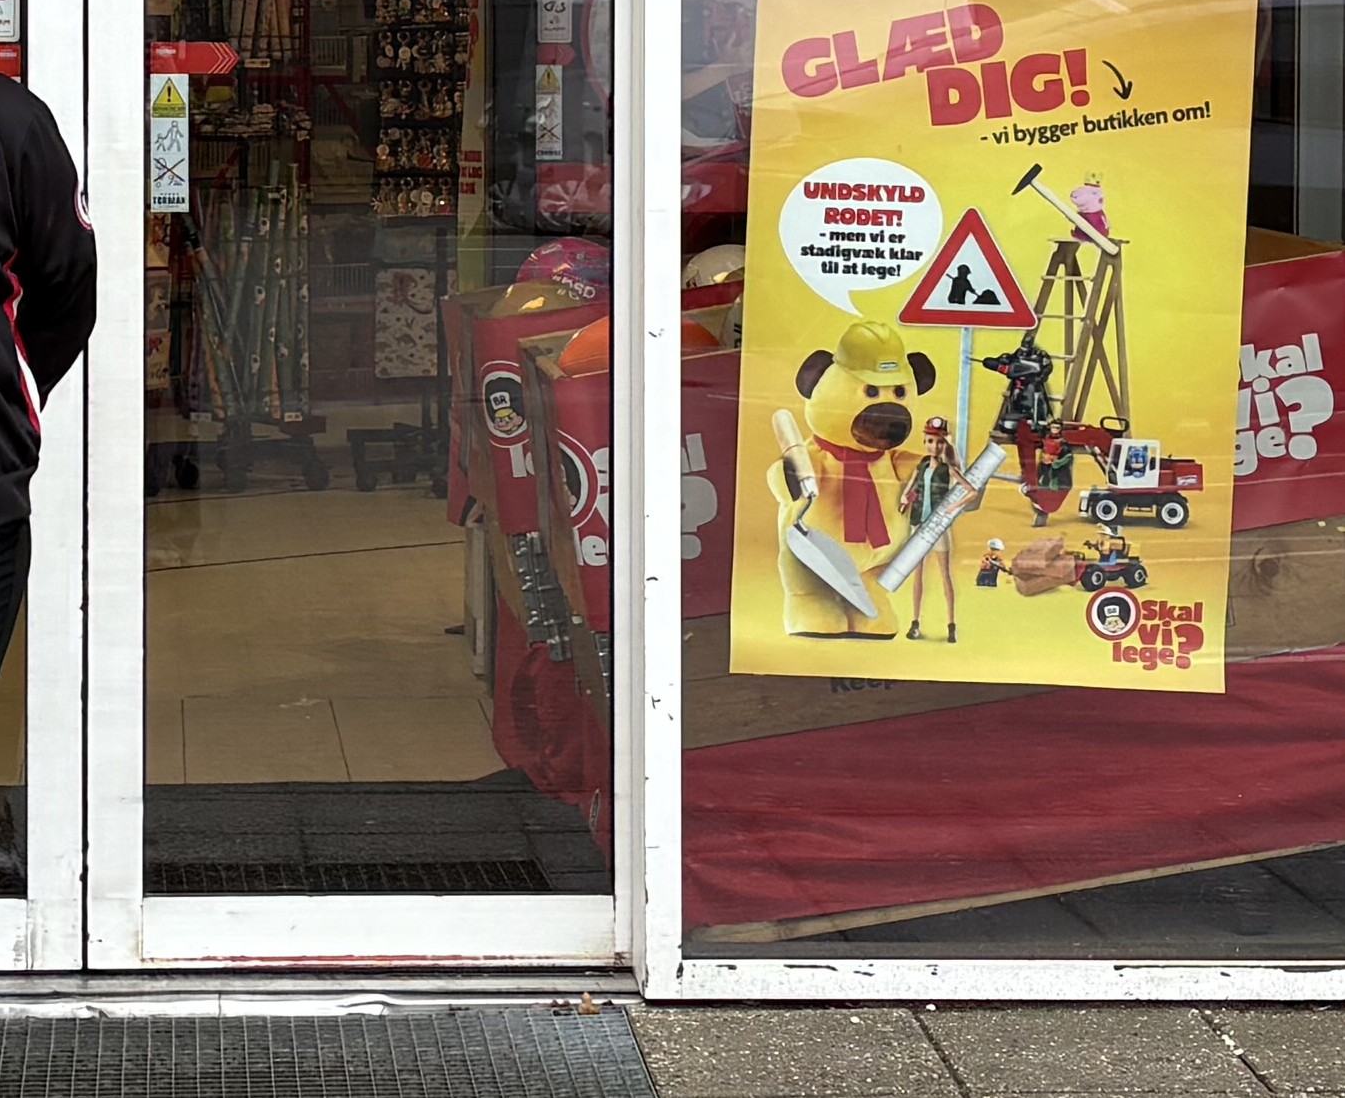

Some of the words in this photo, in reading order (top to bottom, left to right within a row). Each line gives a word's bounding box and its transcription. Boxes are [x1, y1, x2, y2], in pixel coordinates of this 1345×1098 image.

[782, 3, 1003, 98] GLÆD
[926, 48, 1090, 126] DIG!
[992, 126, 1009, 144] vi
[1013, 121, 1079, 146] bygger
[1082, 108, 1168, 133] butikken
[1172, 101, 1211, 122] om!
[804, 182, 925, 203] UNDSKYLD
[824, 207, 903, 227] RODET!
[829, 231, 866, 243] men
[870, 230, 885, 243] vi
[888, 233, 906, 244] er
[801, 244, 886, 261] stadigvæk
[889, 248, 923, 261] klar
[821, 261, 839, 274] til
[842, 262, 859, 274] at
[861, 263, 902, 279] lege!
[1237, 333, 1324, 382] kal
[493, 395, 508, 405] BR
[1141, 600, 1203, 623] Skal
